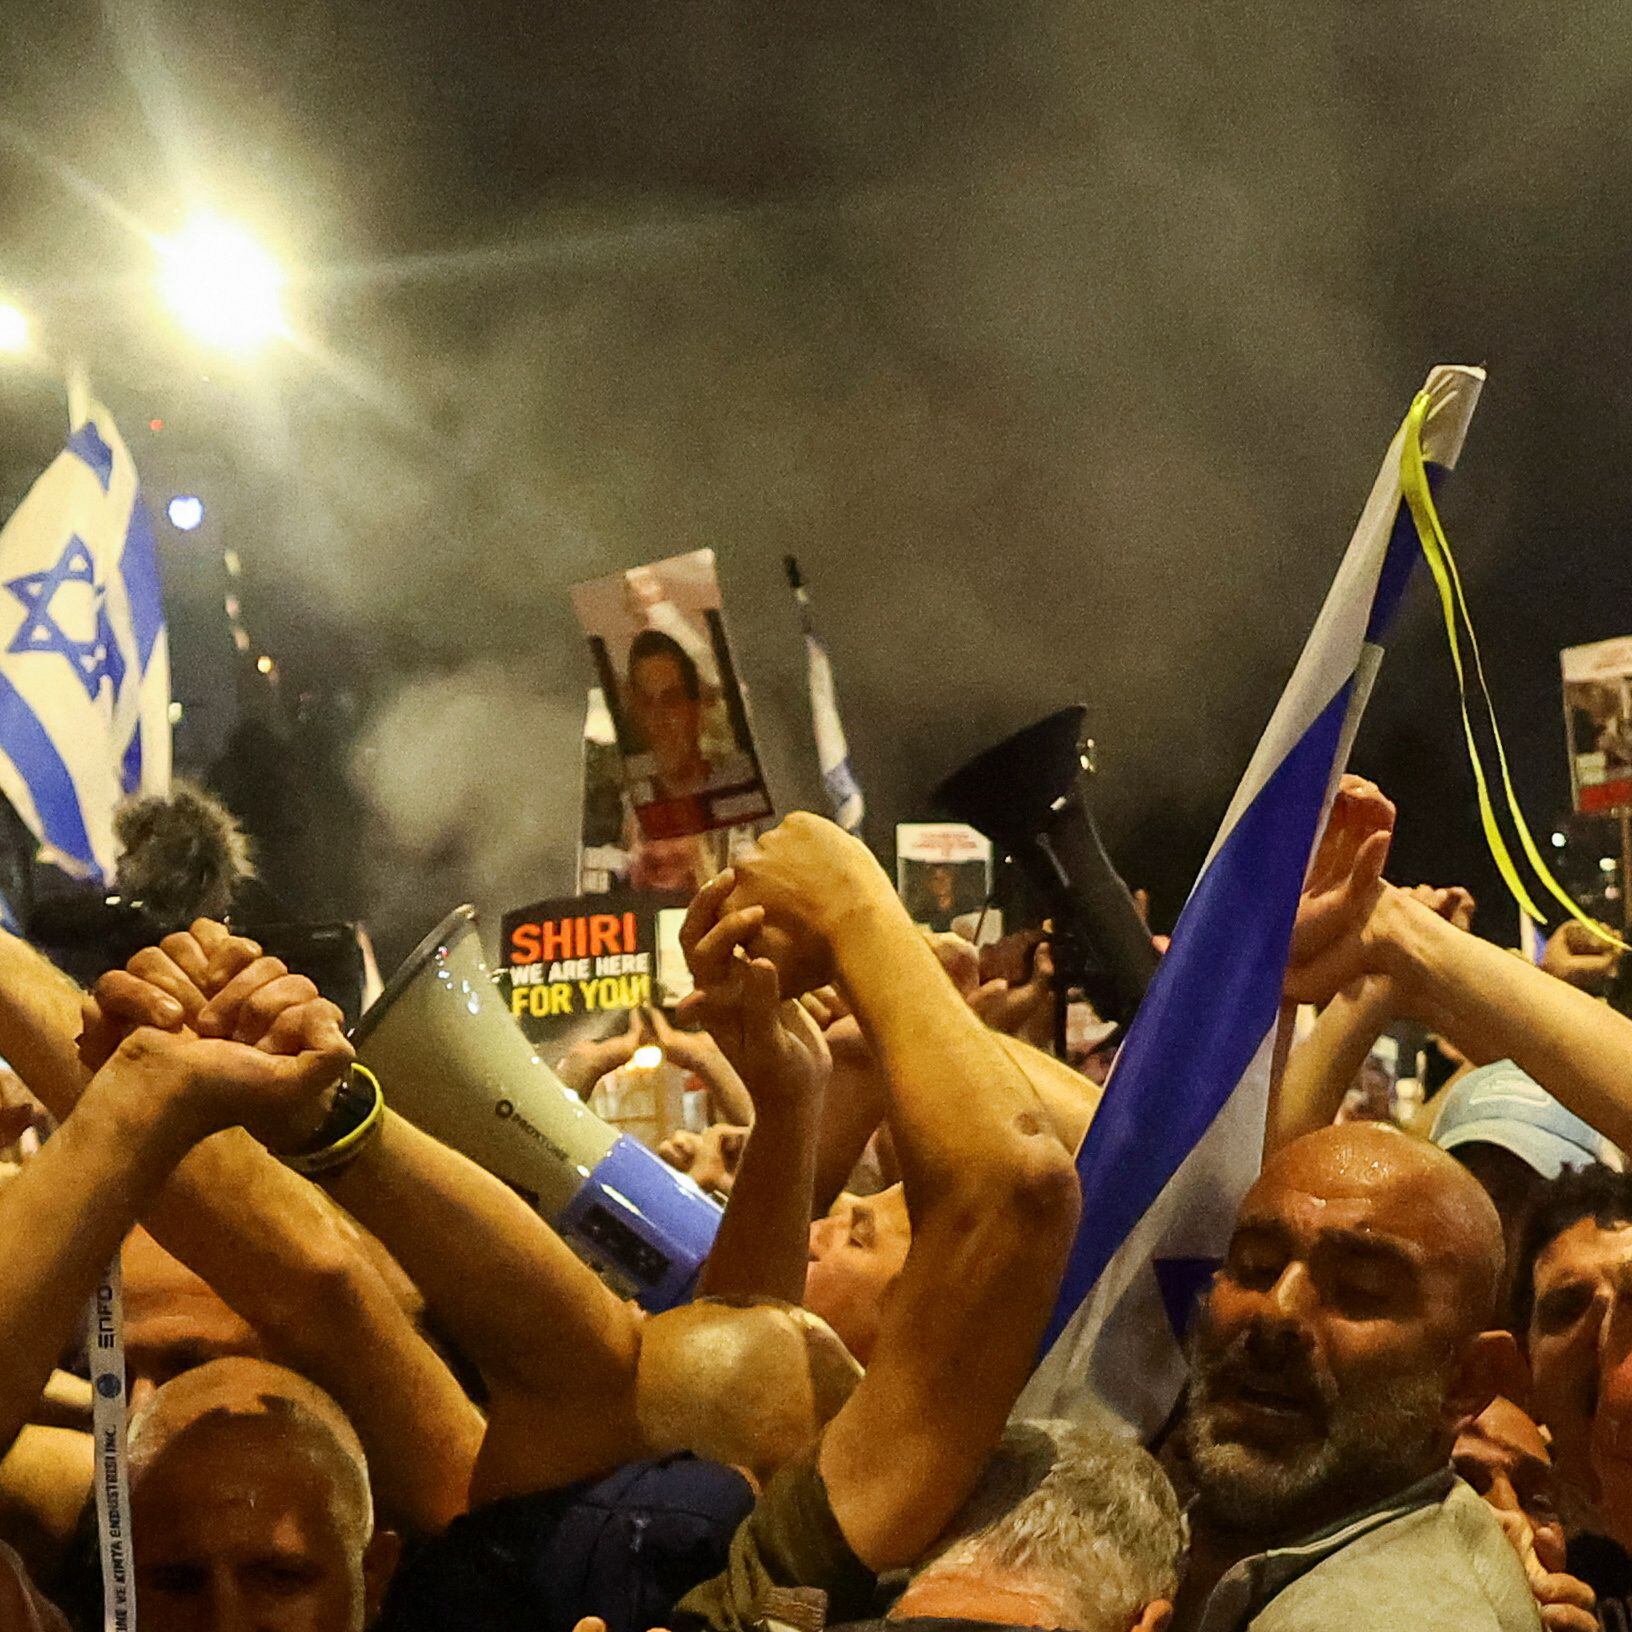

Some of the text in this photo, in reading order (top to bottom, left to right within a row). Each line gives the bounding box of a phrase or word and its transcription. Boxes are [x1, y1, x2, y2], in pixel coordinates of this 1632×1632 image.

[510, 911, 637, 966] SHIRI
[510, 952, 650, 987] WE ARE HERE
[511, 983, 574, 1018] FOR
